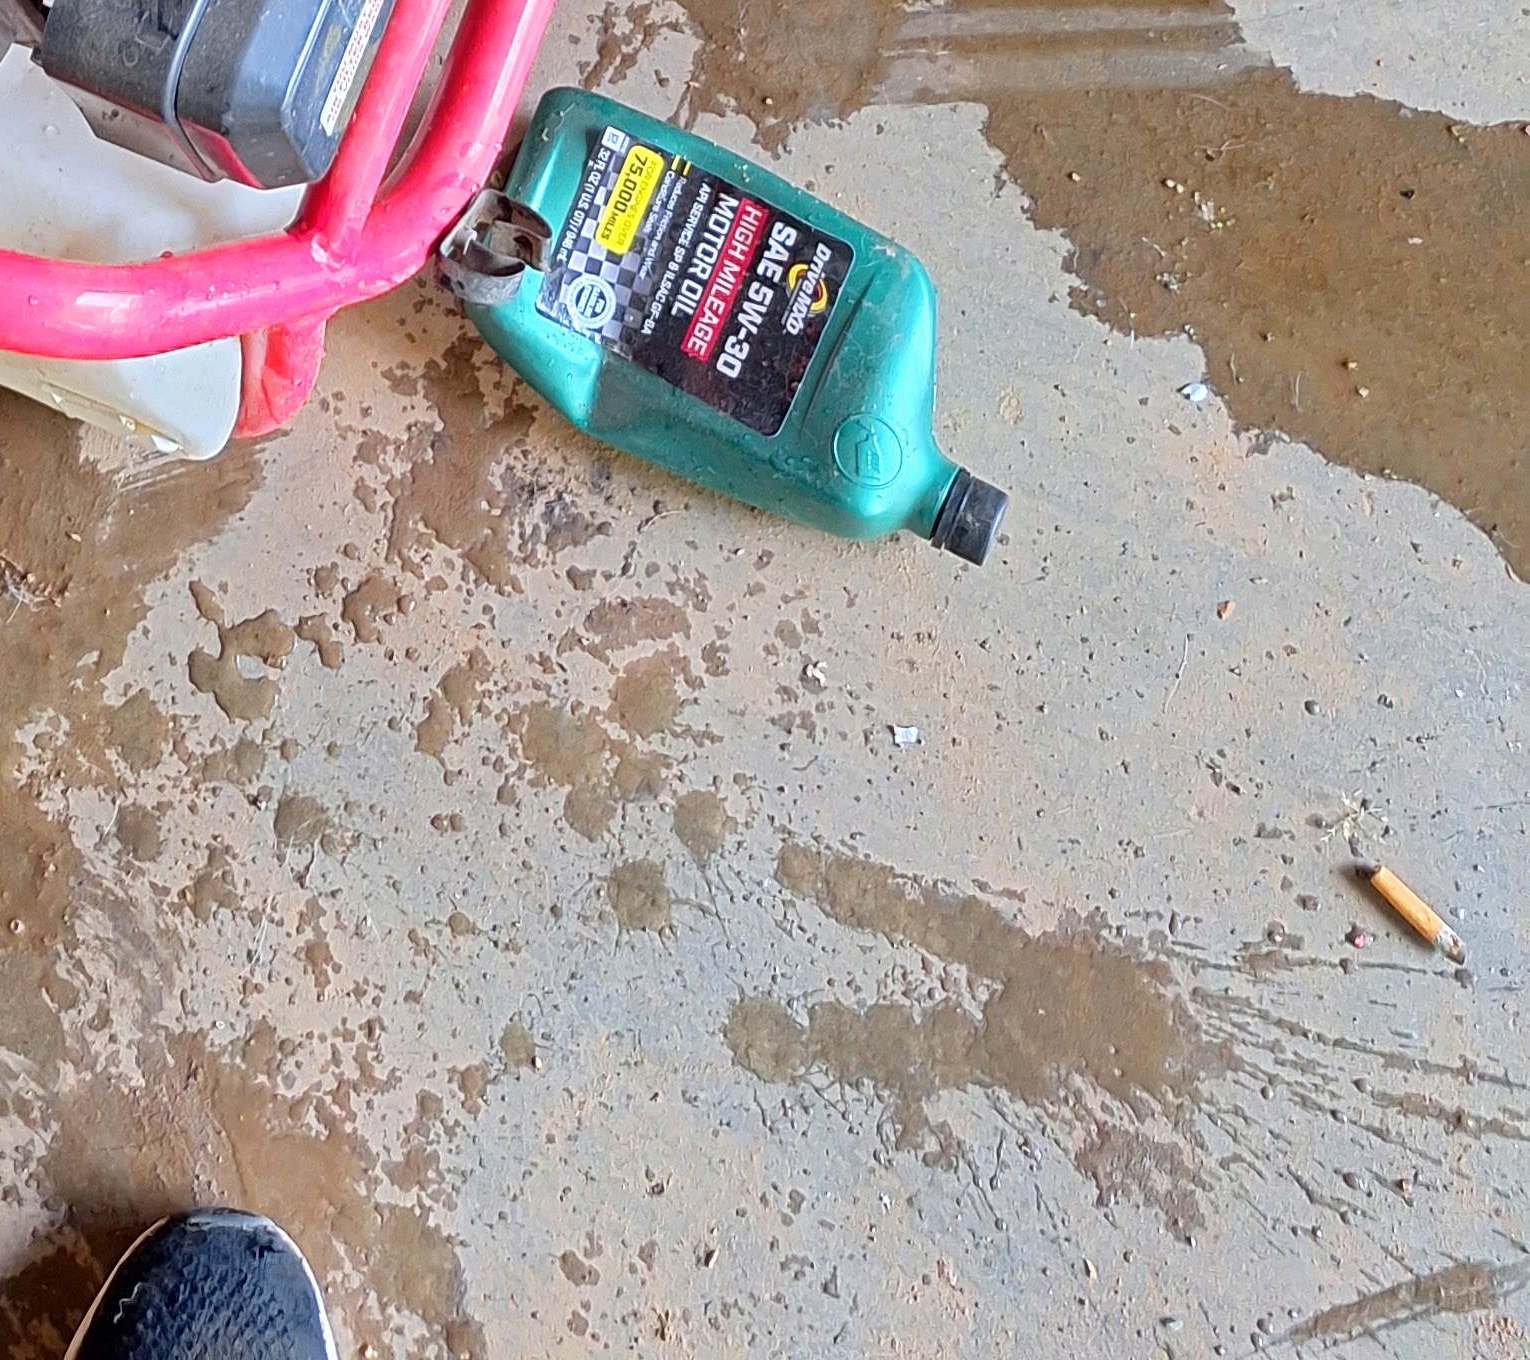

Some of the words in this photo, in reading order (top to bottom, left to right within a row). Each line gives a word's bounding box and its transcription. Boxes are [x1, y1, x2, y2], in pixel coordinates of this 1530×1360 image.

[597, 147, 610, 161] 32
[642, 159, 656, 180] FOR
[588, 170, 600, 184] OZ
[611, 151, 647, 213] 75,000
[649, 168, 676, 213] Conditions
[664, 174, 686, 211] Reduces
[693, 182, 711, 205] API
[626, 178, 649, 220] ENGINES
[599, 209, 619, 241] MILES
[615, 218, 632, 246] OVER
[641, 210, 658, 235] Seals
[650, 207, 672, 242] Friction
[676, 202, 703, 248] SERVICE
[686, 190, 740, 281] MOTOR
[725, 203, 764, 263] HIGH
[645, 238, 660, 258] and
[670, 245, 685, 263] SP
[753, 219, 799, 284] SAE
[635, 255, 653, 282] Wear
[653, 269, 675, 303] ILSAC
[669, 277, 704, 322] OIL
[685, 257, 741, 357] MILEAGE
[713, 277, 775, 380] 5W-30
